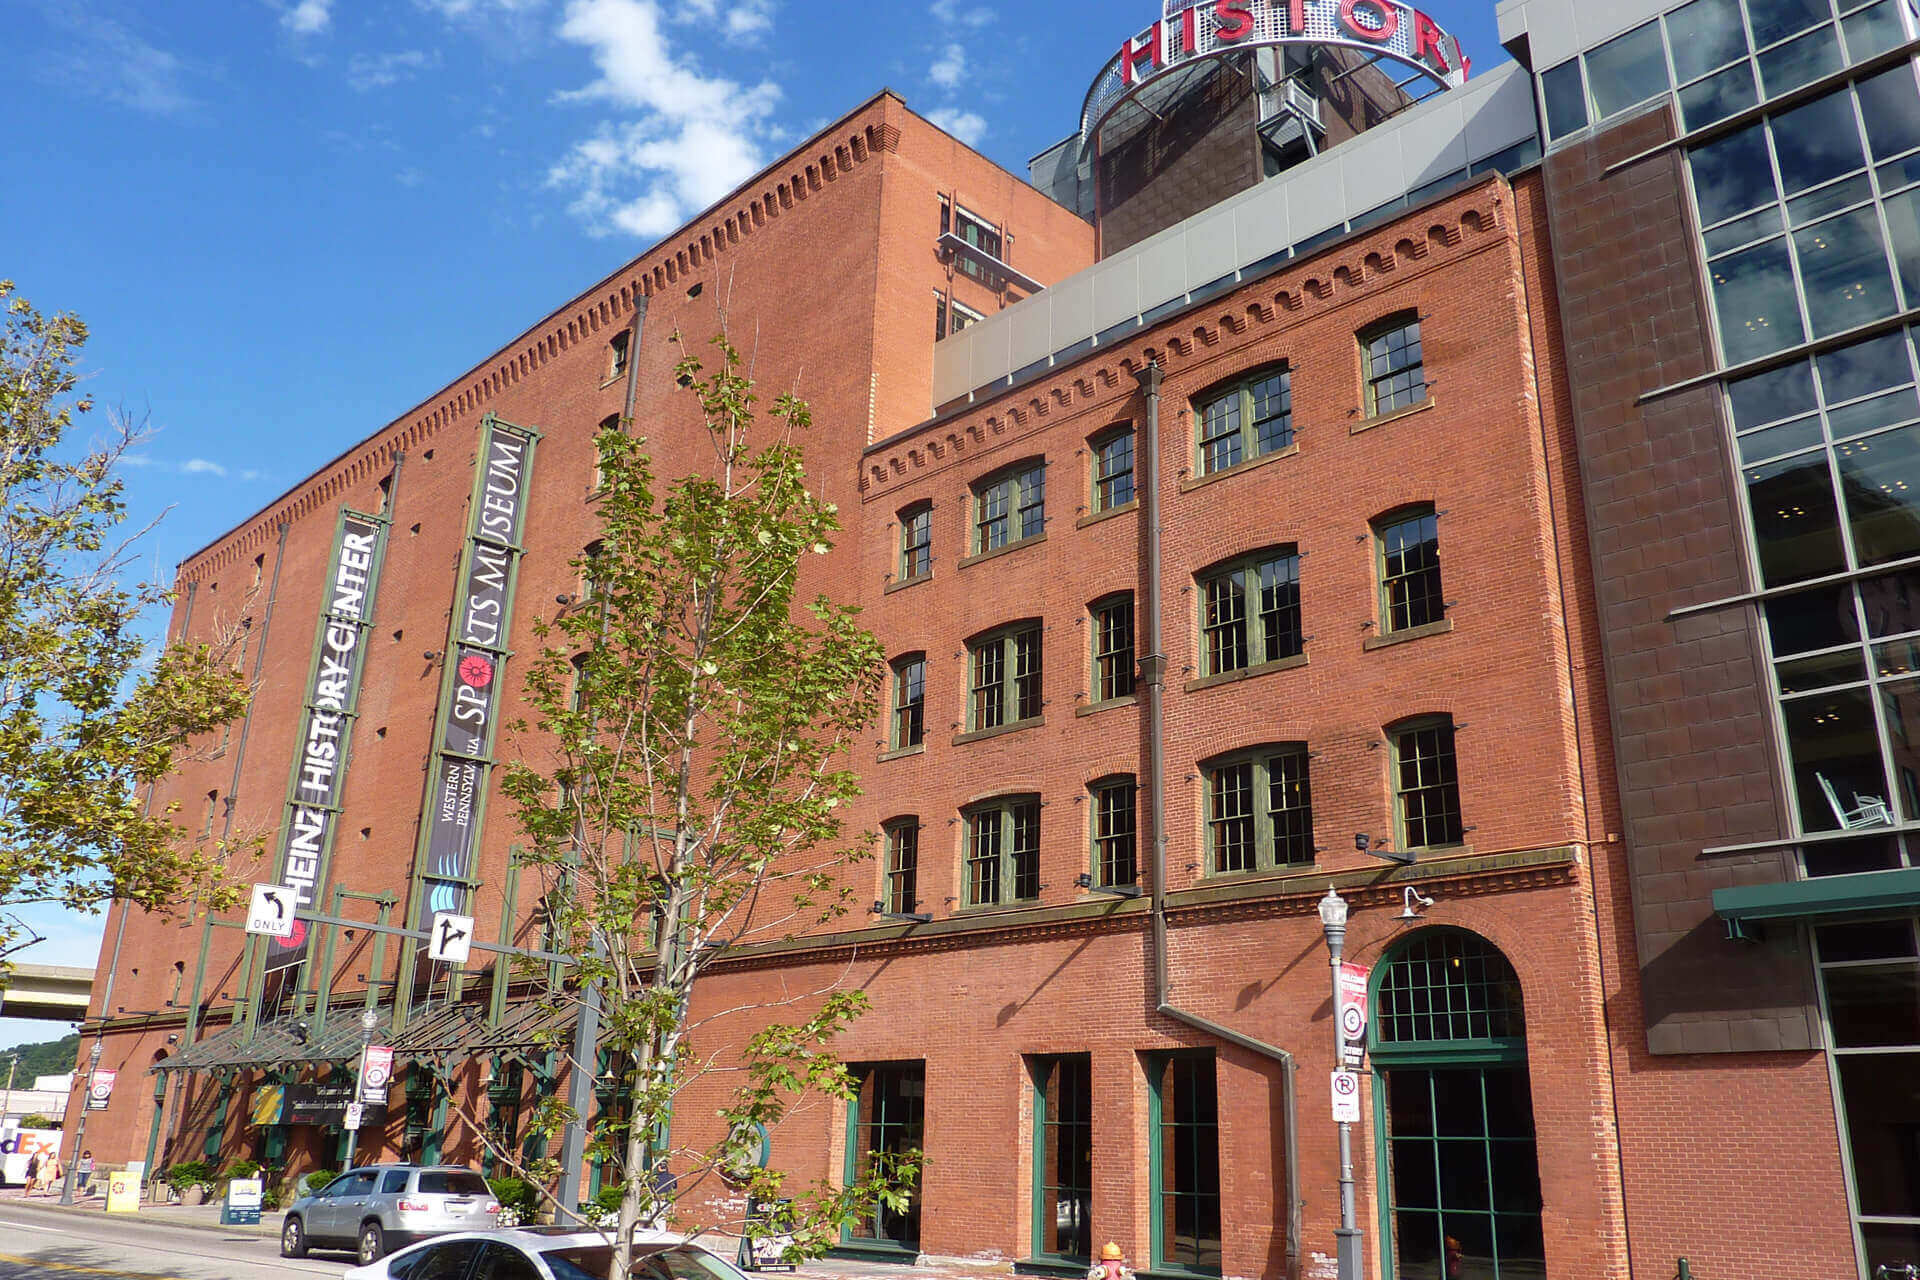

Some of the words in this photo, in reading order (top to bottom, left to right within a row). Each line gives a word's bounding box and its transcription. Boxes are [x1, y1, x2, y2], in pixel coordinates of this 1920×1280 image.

[1122, 0, 1472, 84] HISTORY
[473, 441, 523, 592] MUSEUM
[327, 532, 374, 652] CENTER
[302, 655, 350, 792] HISTORY
[441, 764, 461, 823] WESTERN
[456, 737, 480, 827] PENNSYLVANIA
[285, 807, 325, 904] HEINZ
[253, 919, 285, 931] ONLY
